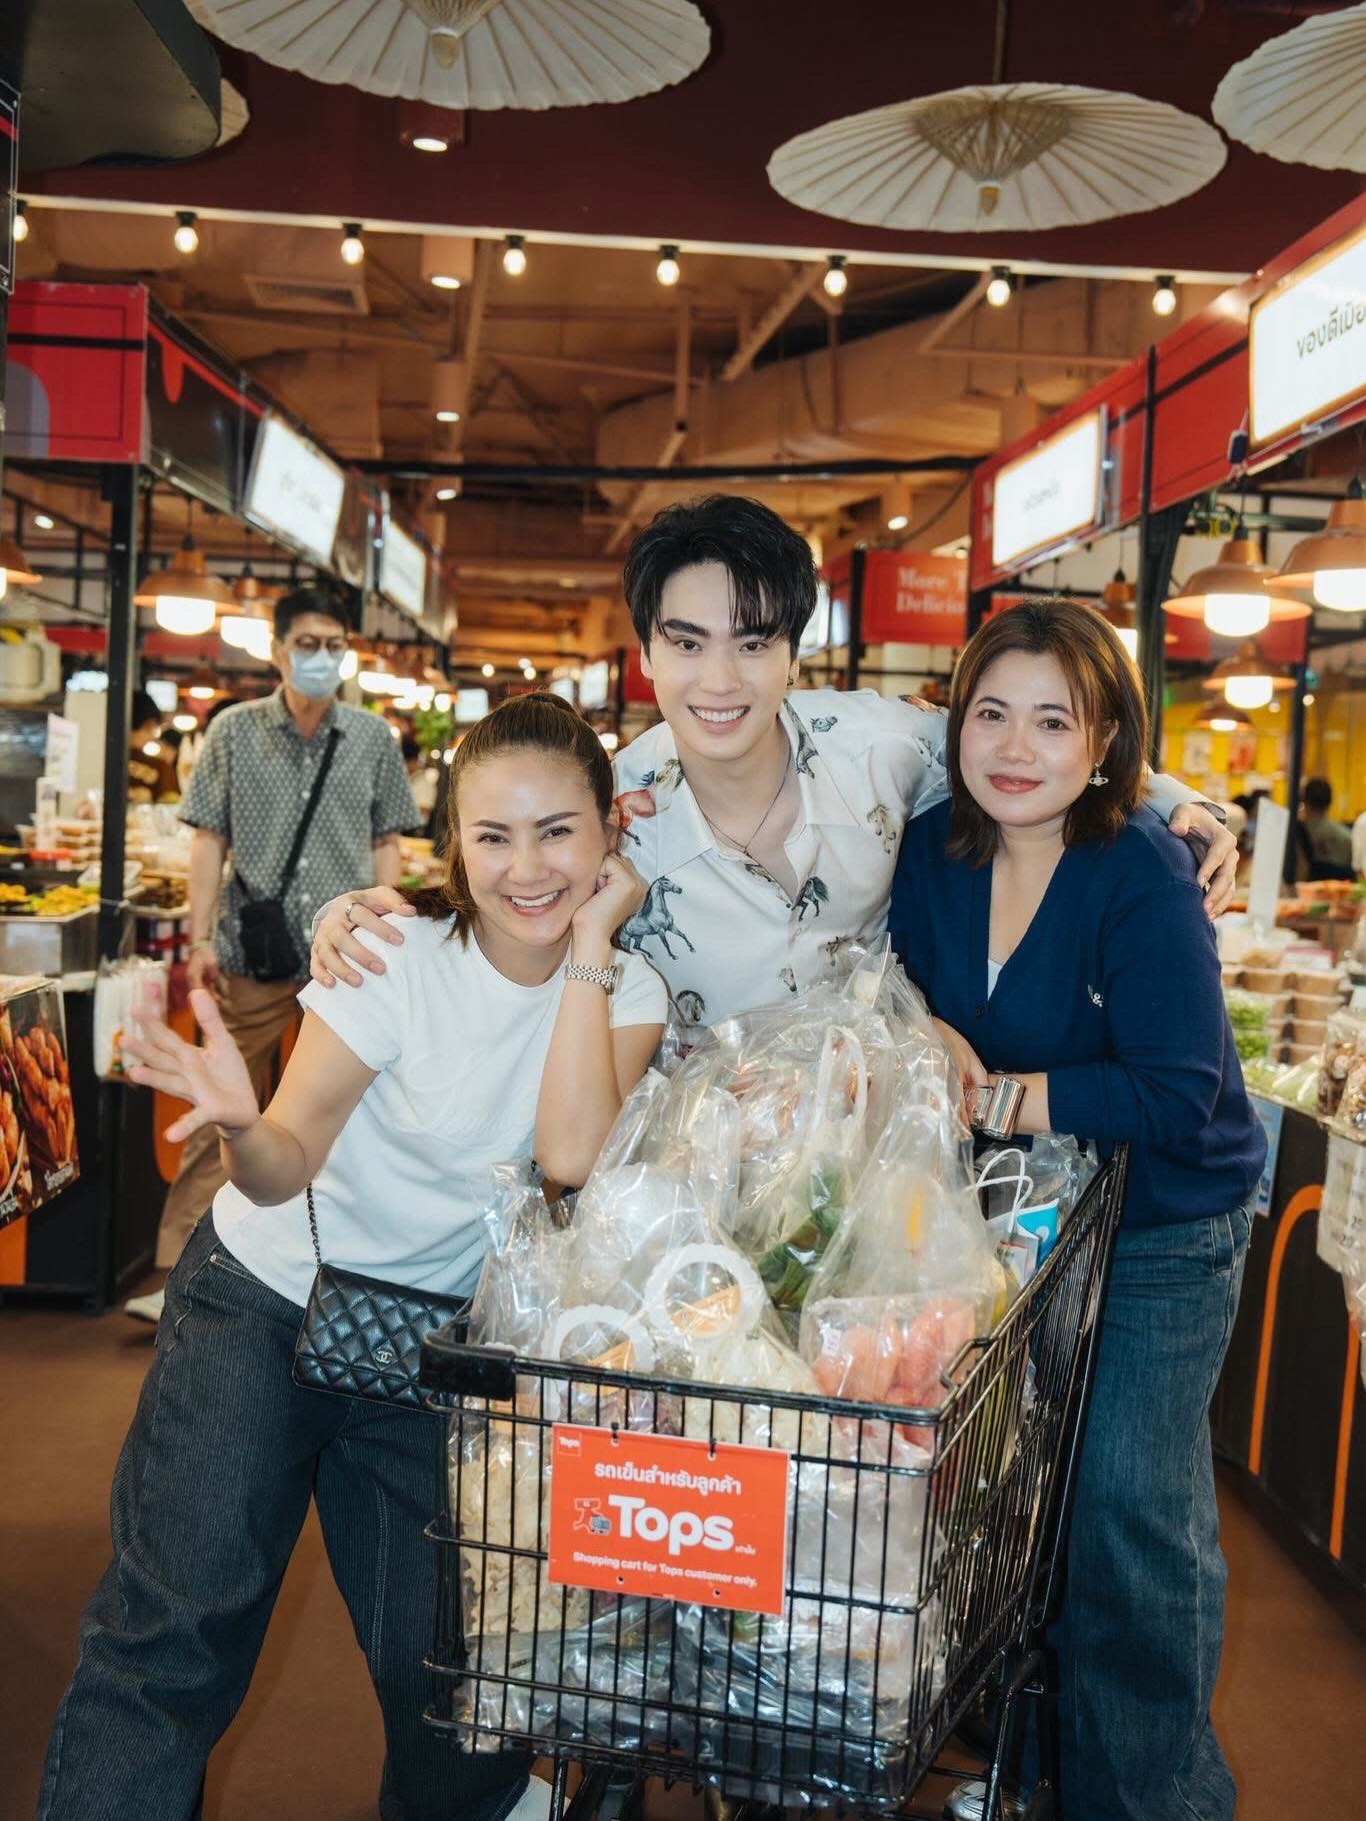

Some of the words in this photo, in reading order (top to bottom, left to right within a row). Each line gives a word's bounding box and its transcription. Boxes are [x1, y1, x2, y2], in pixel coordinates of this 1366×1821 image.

[594, 1461, 742, 1496] รถเข็นสำหรับลูกค้า
[608, 1494, 735, 1555] Tops
[573, 1551, 620, 1569] Shopping
[621, 1559, 641, 1571] cart
[643, 1561, 657, 1572] for
[659, 1562, 683, 1576] Tops
[684, 1568, 732, 1583] customer
[733, 1575, 758, 1588] only.
